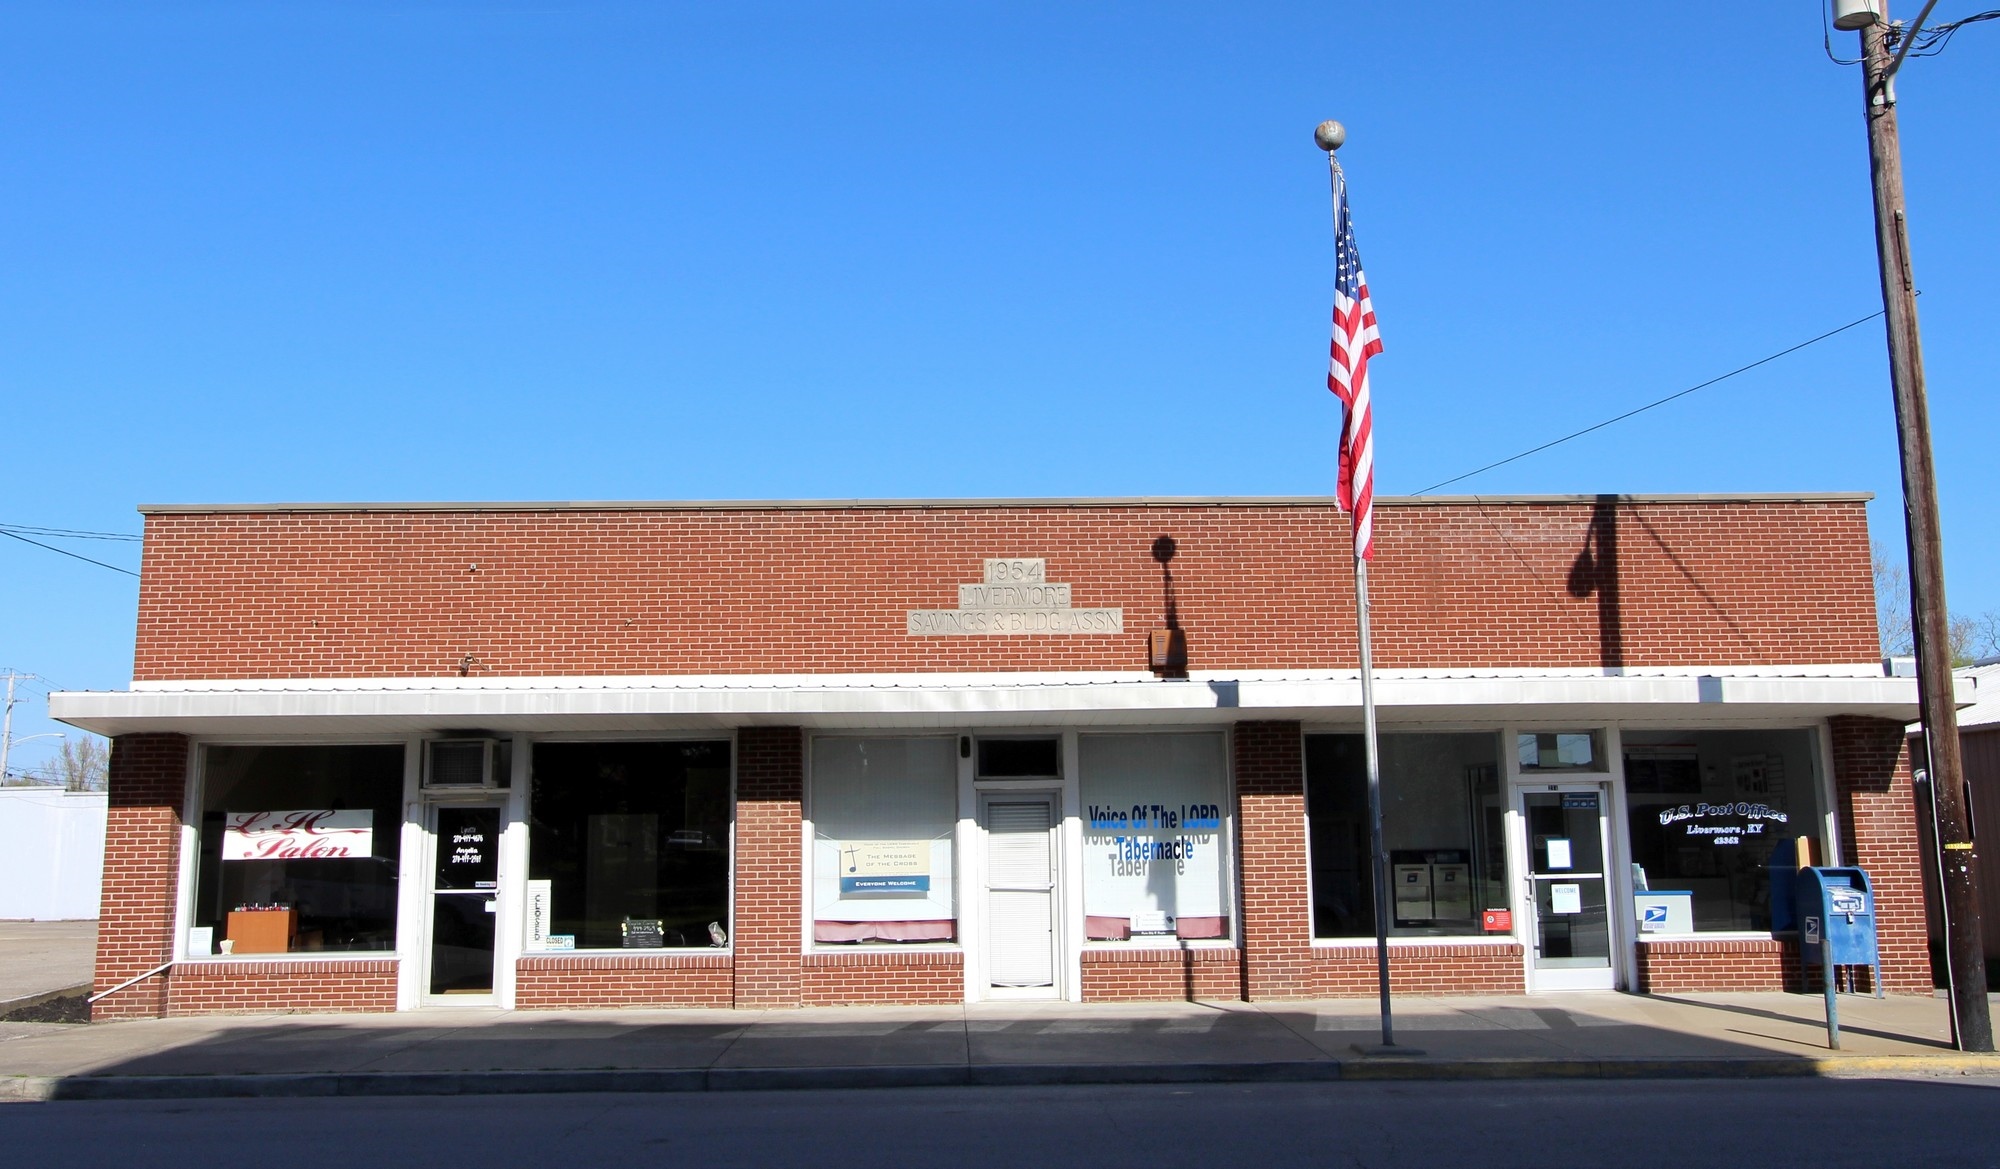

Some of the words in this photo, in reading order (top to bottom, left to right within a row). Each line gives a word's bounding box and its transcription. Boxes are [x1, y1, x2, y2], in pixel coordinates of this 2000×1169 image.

[987, 561, 1042, 581] 1954
[961, 586, 1069, 607] LIVERMORE
[910, 612, 987, 632] SAVINGS
[993, 612, 1005, 631] &
[1010, 612, 1062, 631] BLDG
[1088, 805, 1128, 829] Voice
[1131, 805, 1148, 829] Of
[1151, 805, 1177, 829] The
[1181, 804, 1220, 829] LORD
[1659, 804, 1694, 825] U.S.
[1695, 802, 1734, 818] Post
[1735, 802, 1788, 823] Office
[1747, 823, 1764, 833] KY
[243, 837, 351, 858] Salon
[1116, 835, 1193, 861] Tabernacle
